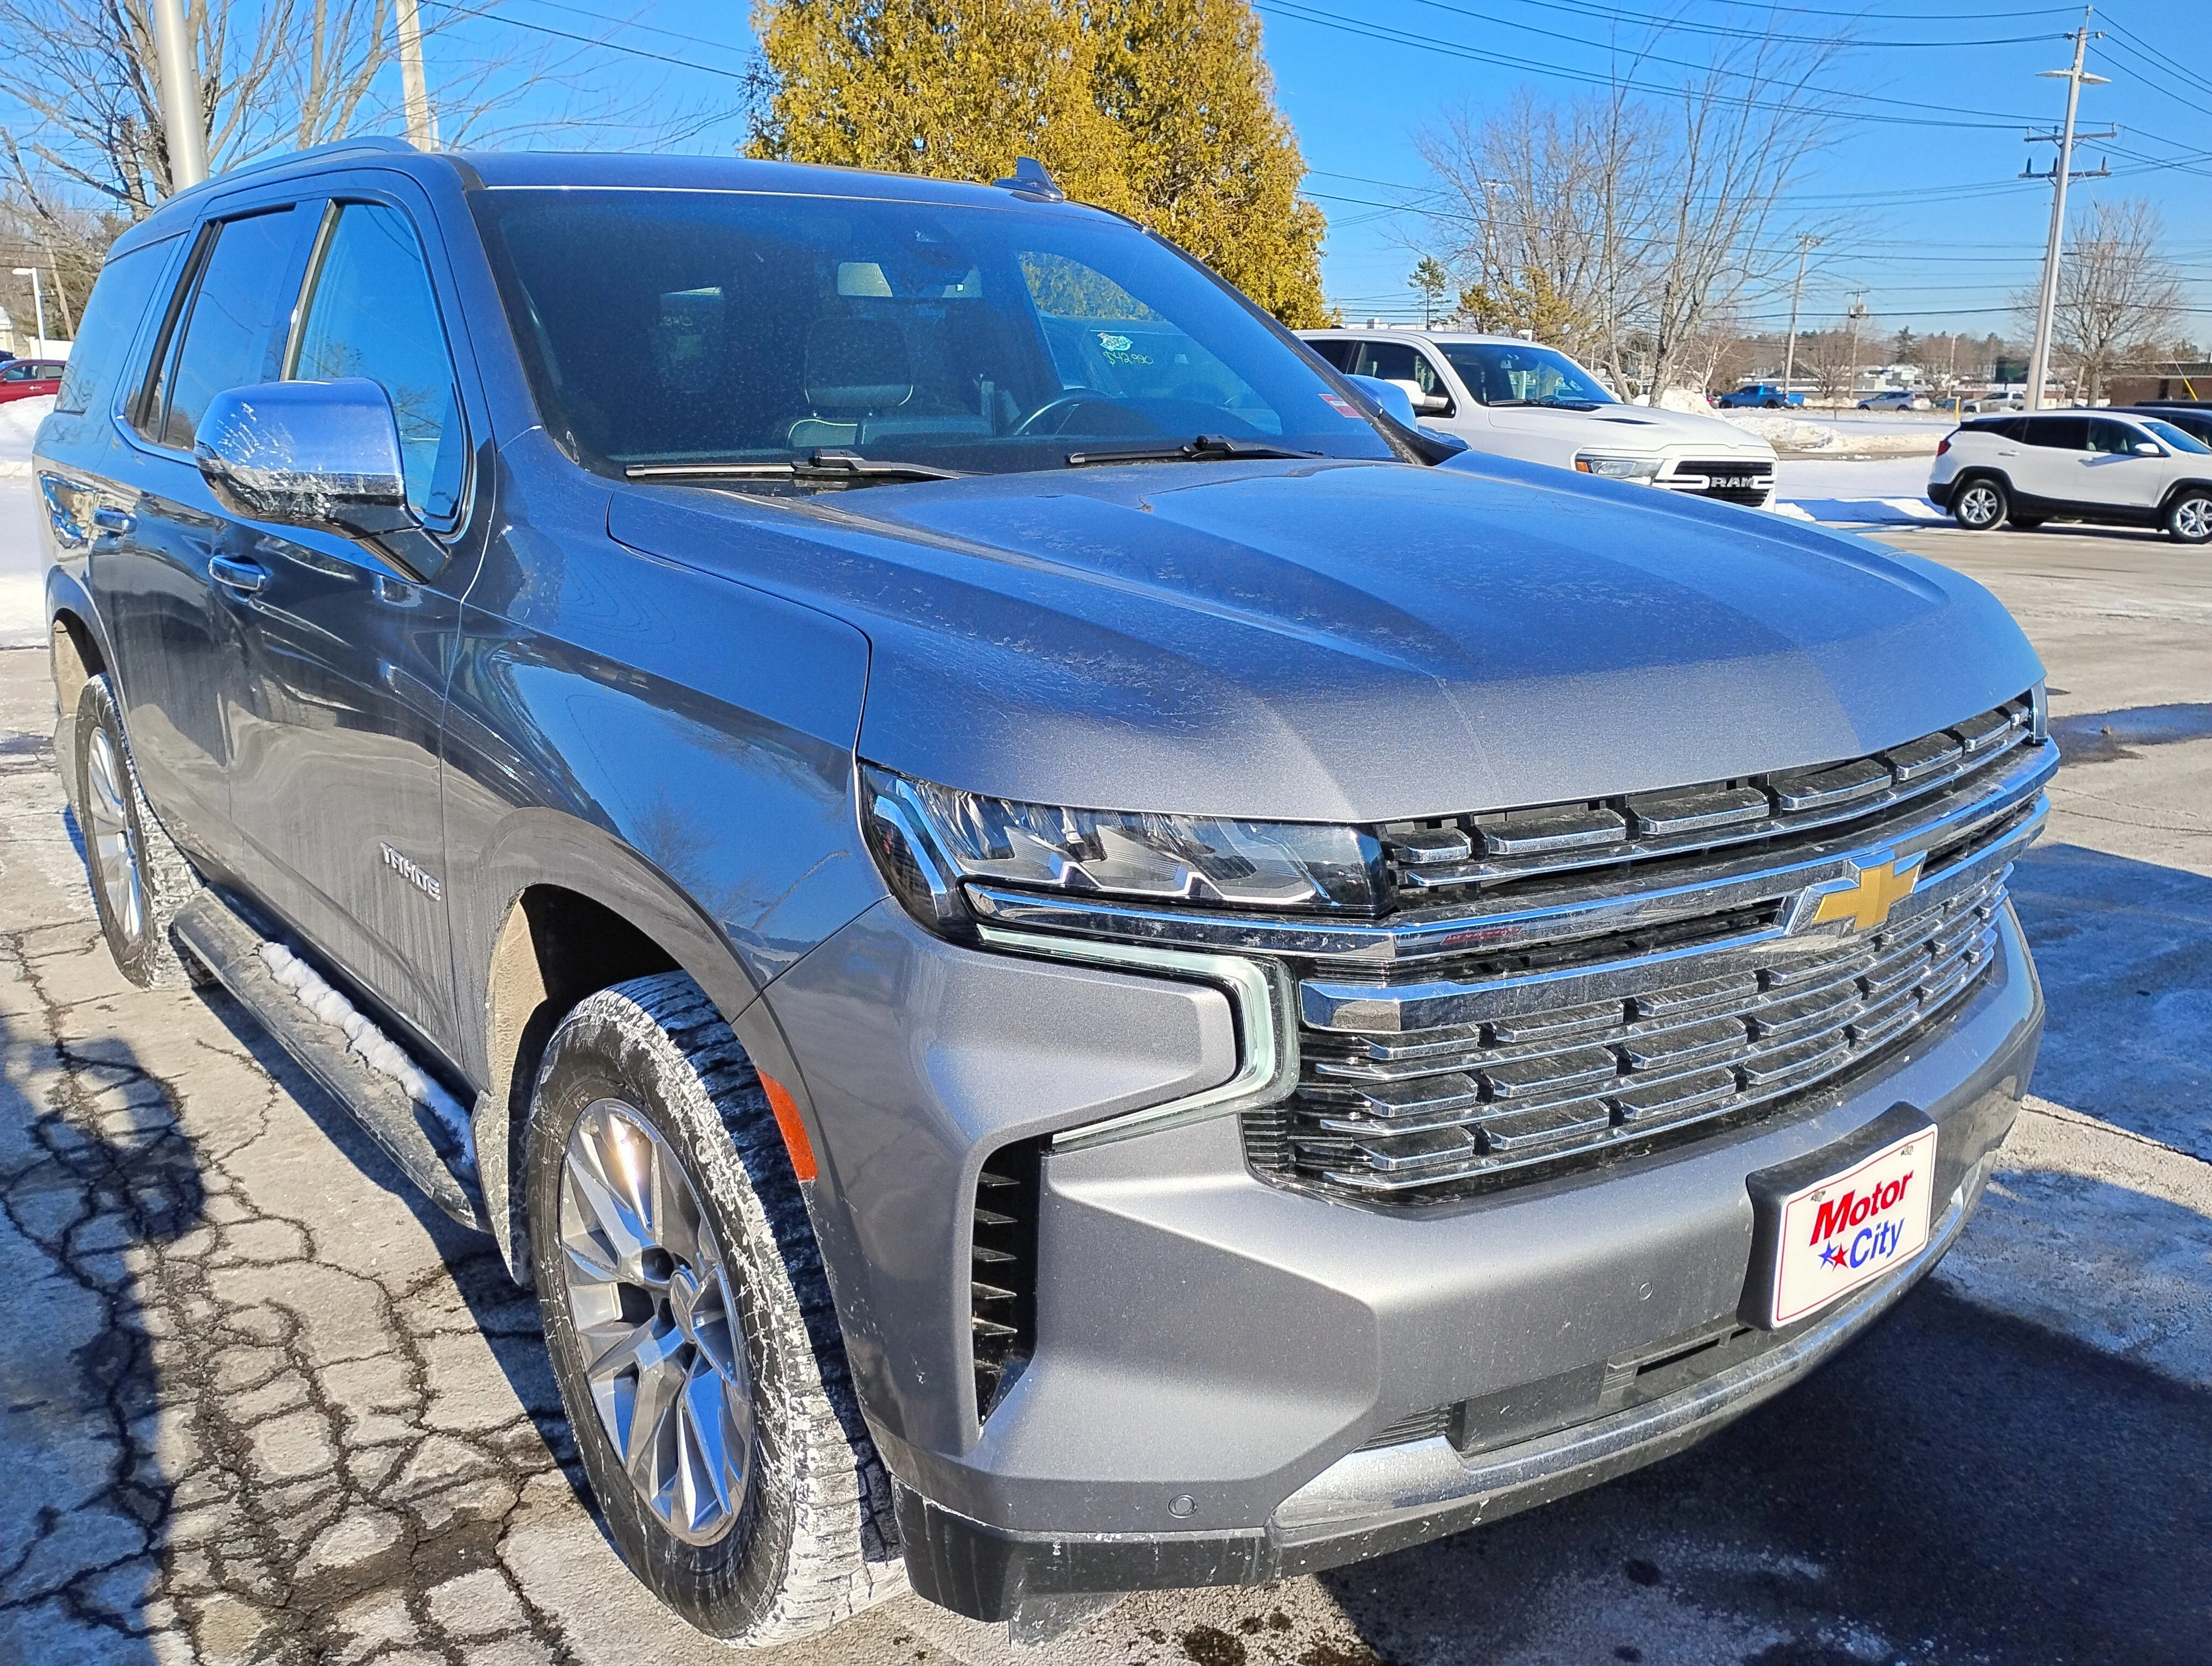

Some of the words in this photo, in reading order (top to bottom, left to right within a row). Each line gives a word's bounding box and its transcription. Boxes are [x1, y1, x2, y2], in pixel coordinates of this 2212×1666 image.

[1711, 477, 1755, 488] RAM
[380, 842, 441, 901] TAHOE
[1809, 1170, 1914, 1246] Motor
[1849, 1218, 1905, 1268] City
